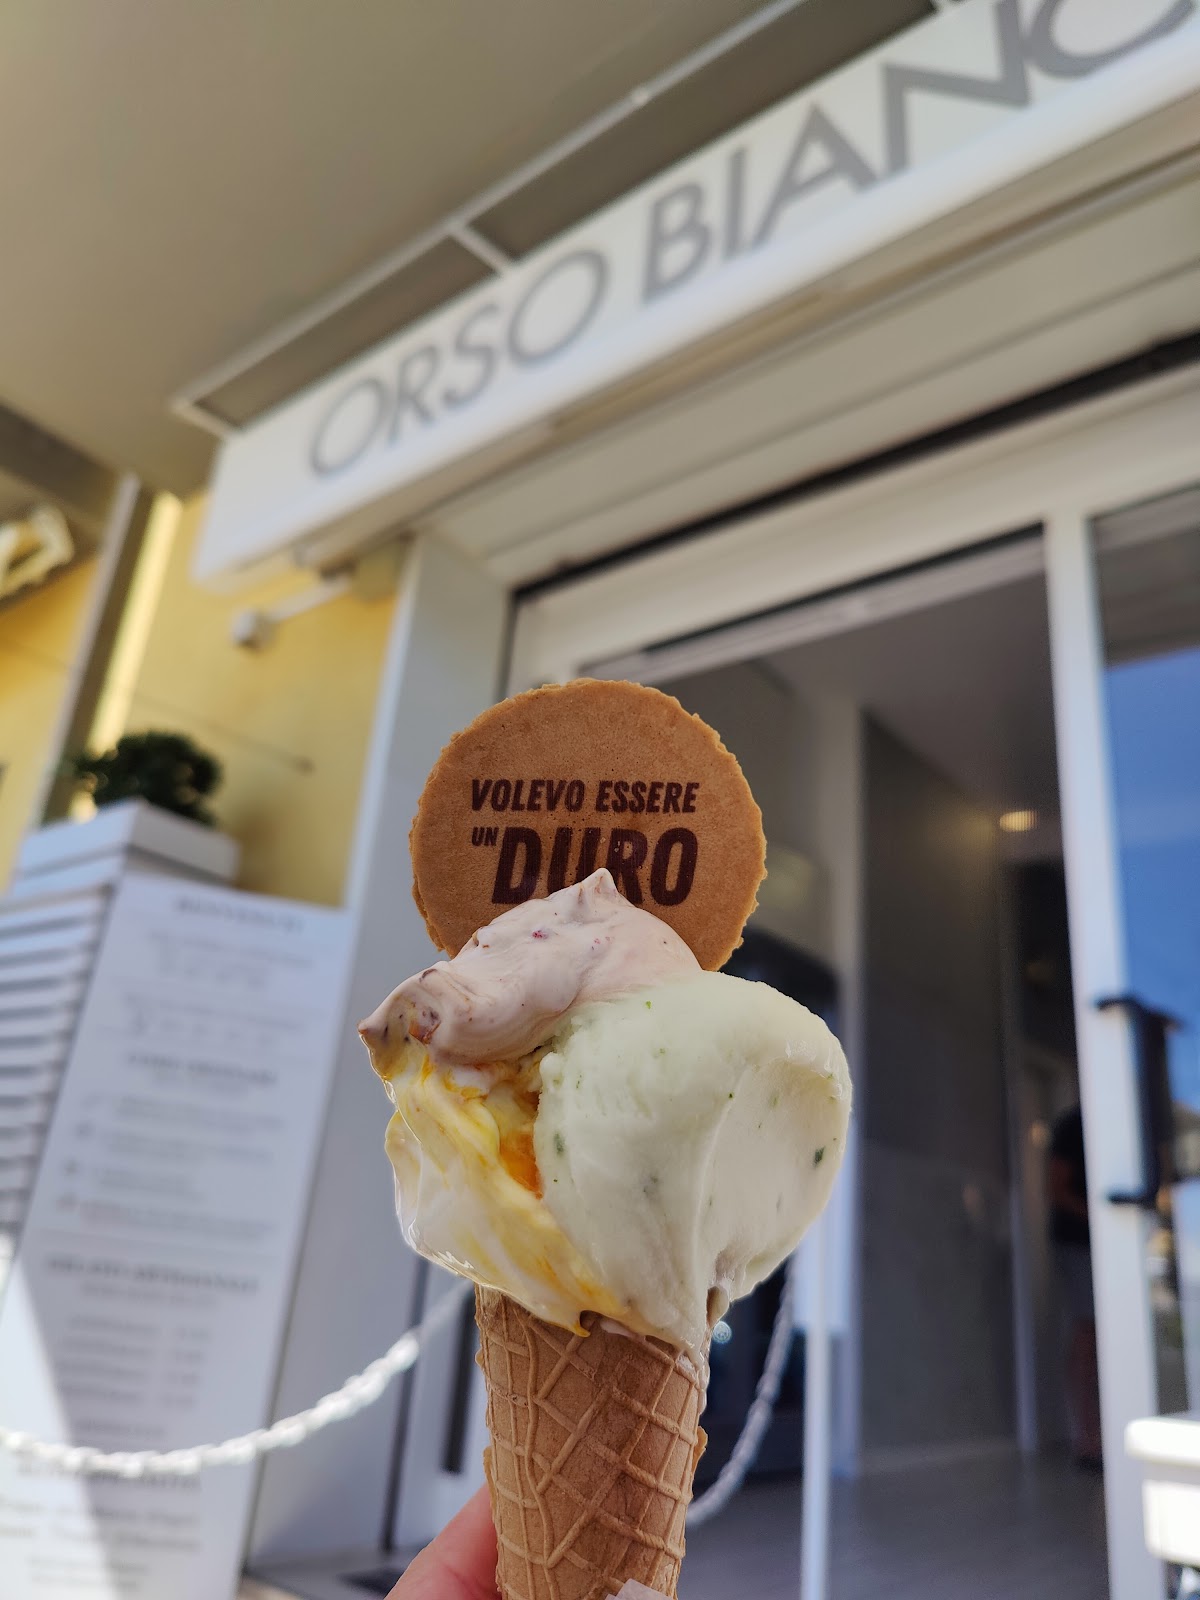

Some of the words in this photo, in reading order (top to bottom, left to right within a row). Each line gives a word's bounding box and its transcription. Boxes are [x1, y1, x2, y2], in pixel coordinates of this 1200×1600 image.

[310, 249, 608, 474] ORSO
[471, 778, 586, 813] VOLEVO
[595, 780, 700, 814] ESSERE
[471, 826, 500, 847] UN
[491, 826, 699, 907] DURO
